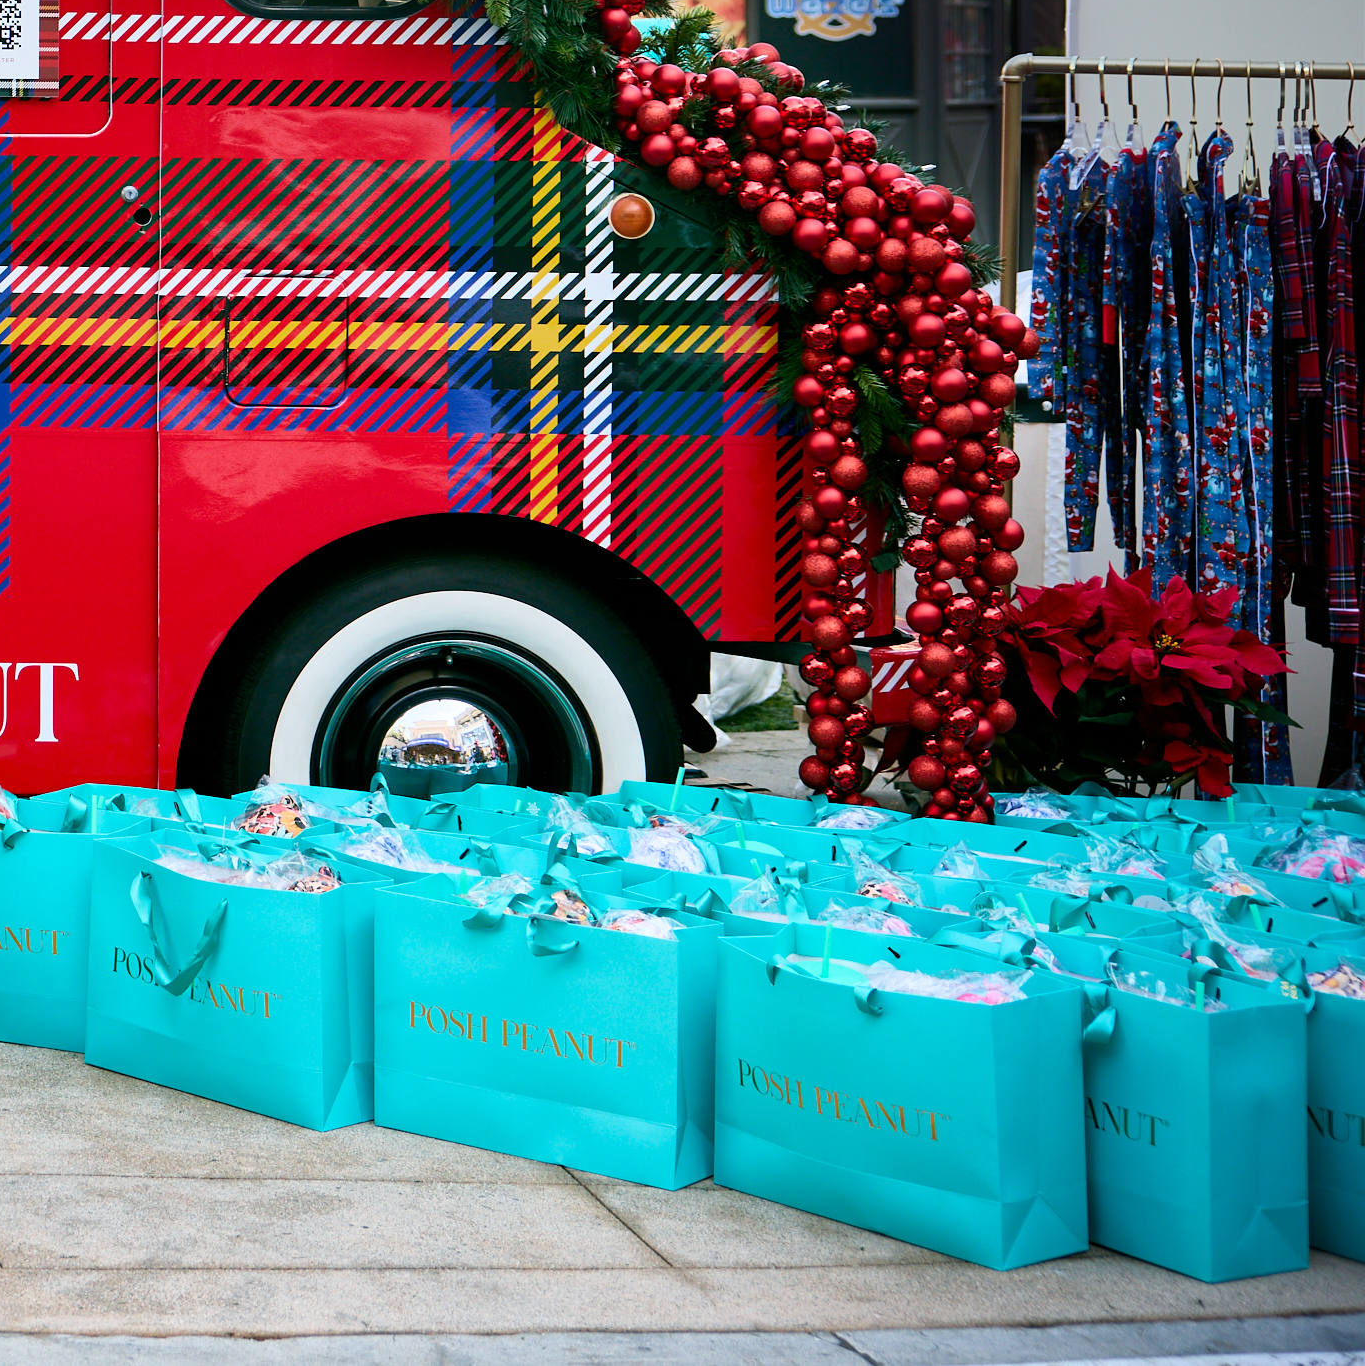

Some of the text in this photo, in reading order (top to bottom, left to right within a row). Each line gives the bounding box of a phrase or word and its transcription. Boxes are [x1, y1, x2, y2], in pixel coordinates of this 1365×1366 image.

[112, 946, 278, 1019] POS EANUT
[408, 1000, 632, 1069] POSH PEANUT
[738, 1058, 945, 1142] POSH PEANUT
[1085, 1095, 1164, 1148] ANUT
